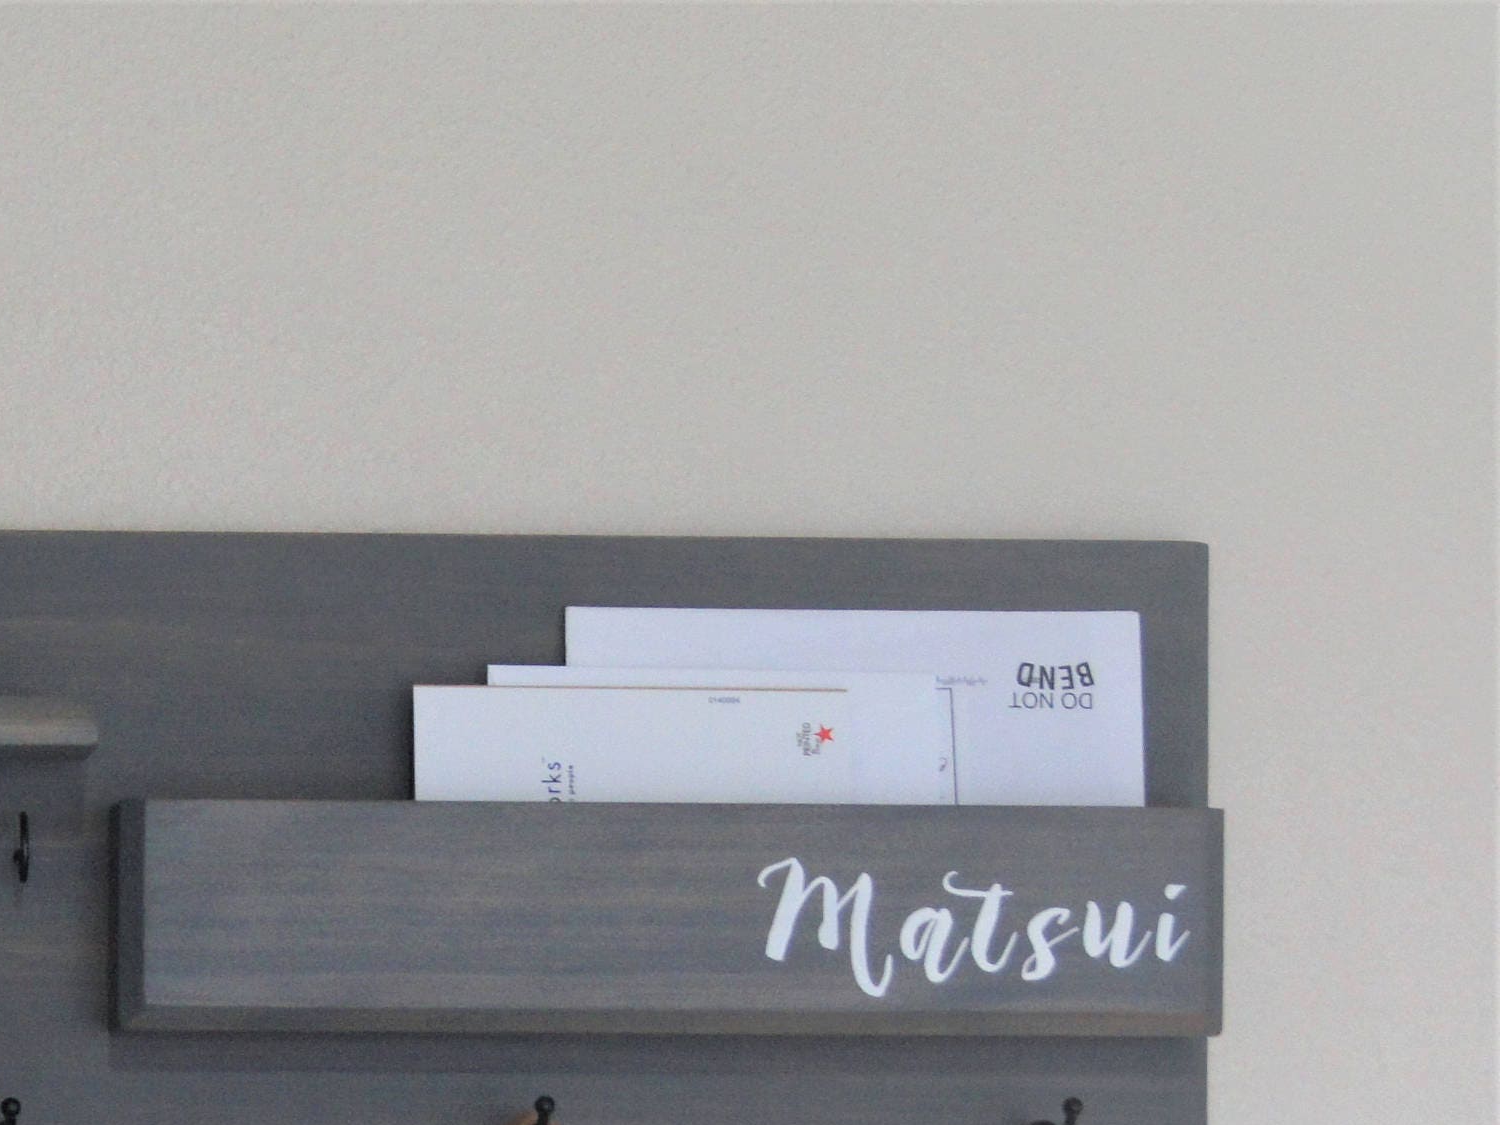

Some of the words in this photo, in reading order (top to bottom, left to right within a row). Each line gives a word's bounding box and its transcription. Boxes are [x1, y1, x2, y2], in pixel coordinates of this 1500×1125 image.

[1016, 662, 1095, 690] BEND
[1008, 691, 1054, 709] NOT
[1061, 692, 1093, 710] DO
[757, 856, 1190, 998] Matsui
